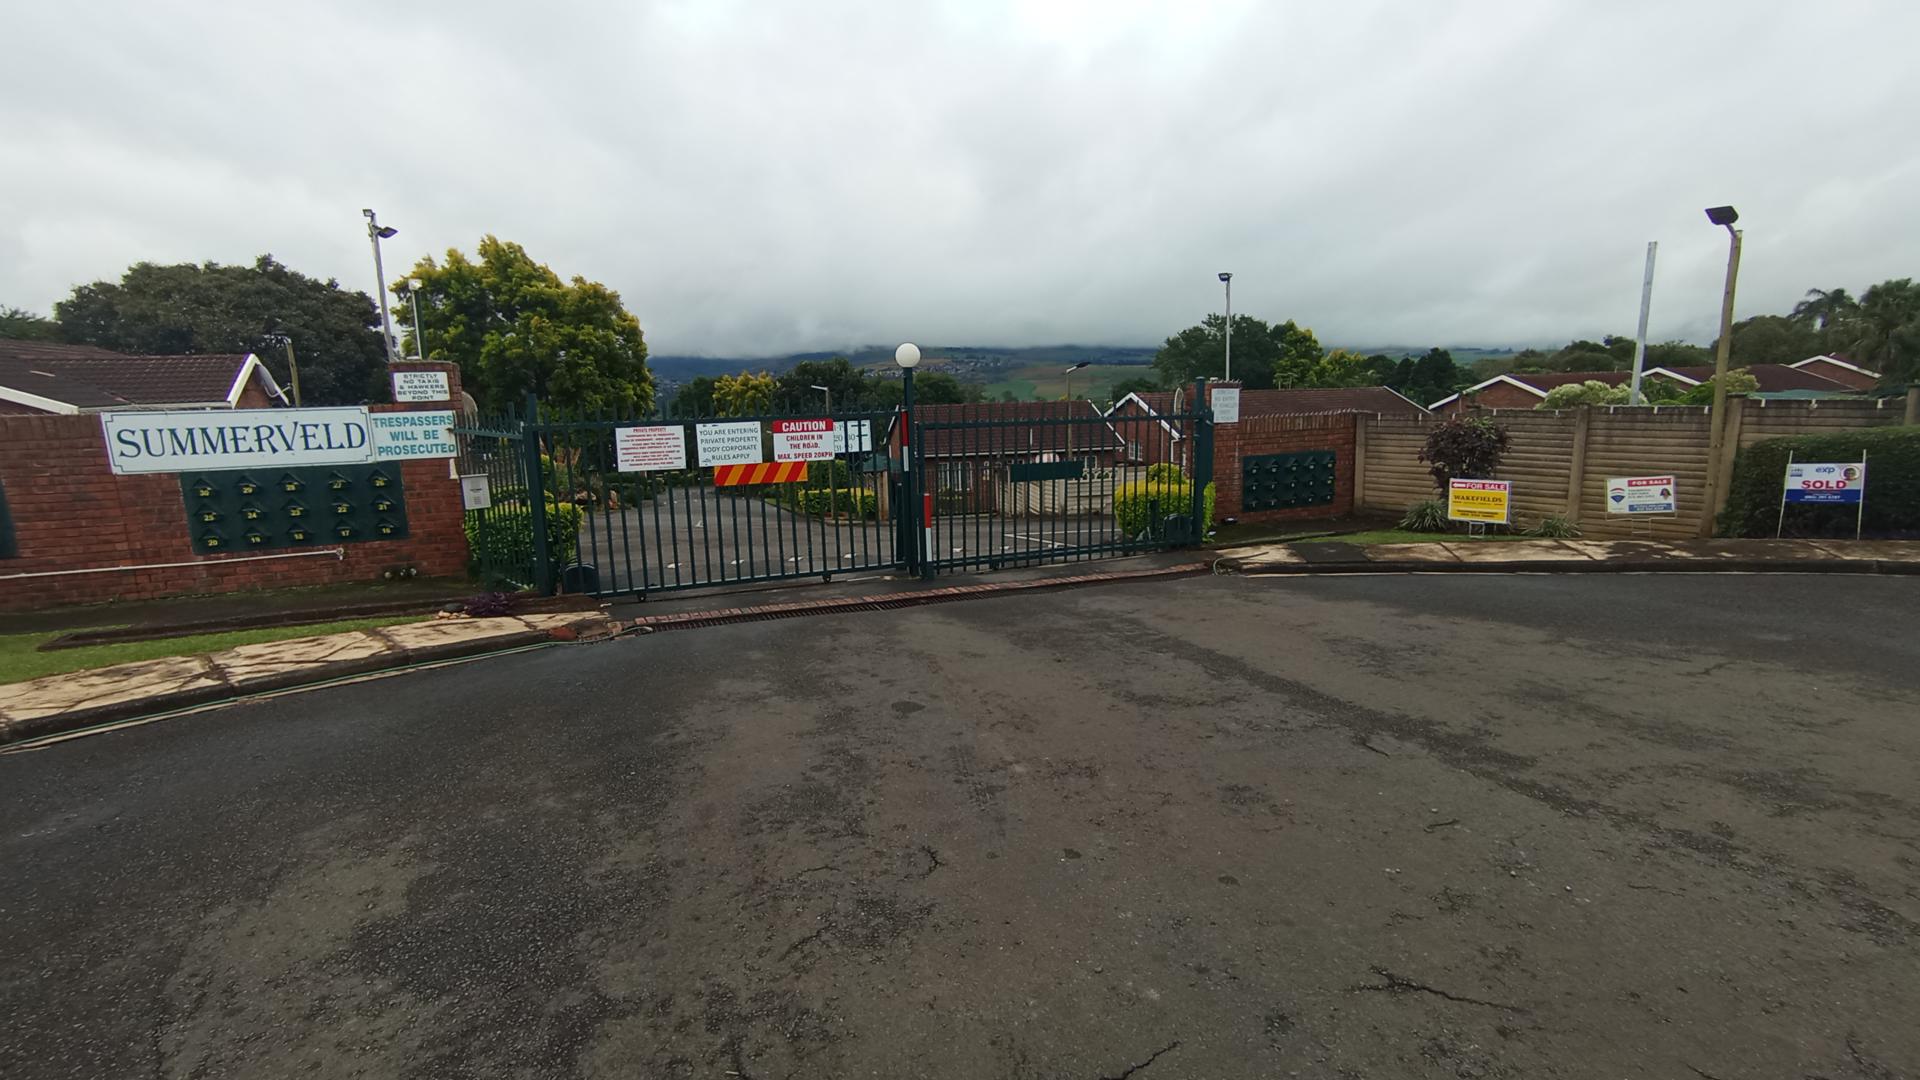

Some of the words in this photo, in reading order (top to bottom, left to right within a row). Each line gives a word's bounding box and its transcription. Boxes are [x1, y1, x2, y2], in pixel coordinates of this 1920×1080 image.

[372, 415, 453, 428] TRESPASSERS
[782, 421, 826, 432] CAUTION
[116, 421, 366, 458] SUMMERVELD
[390, 430, 418, 441] WILL
[424, 430, 439, 440] BE
[378, 443, 456, 456] PROSECUTED
[1802, 480, 1846, 489] SOLD
